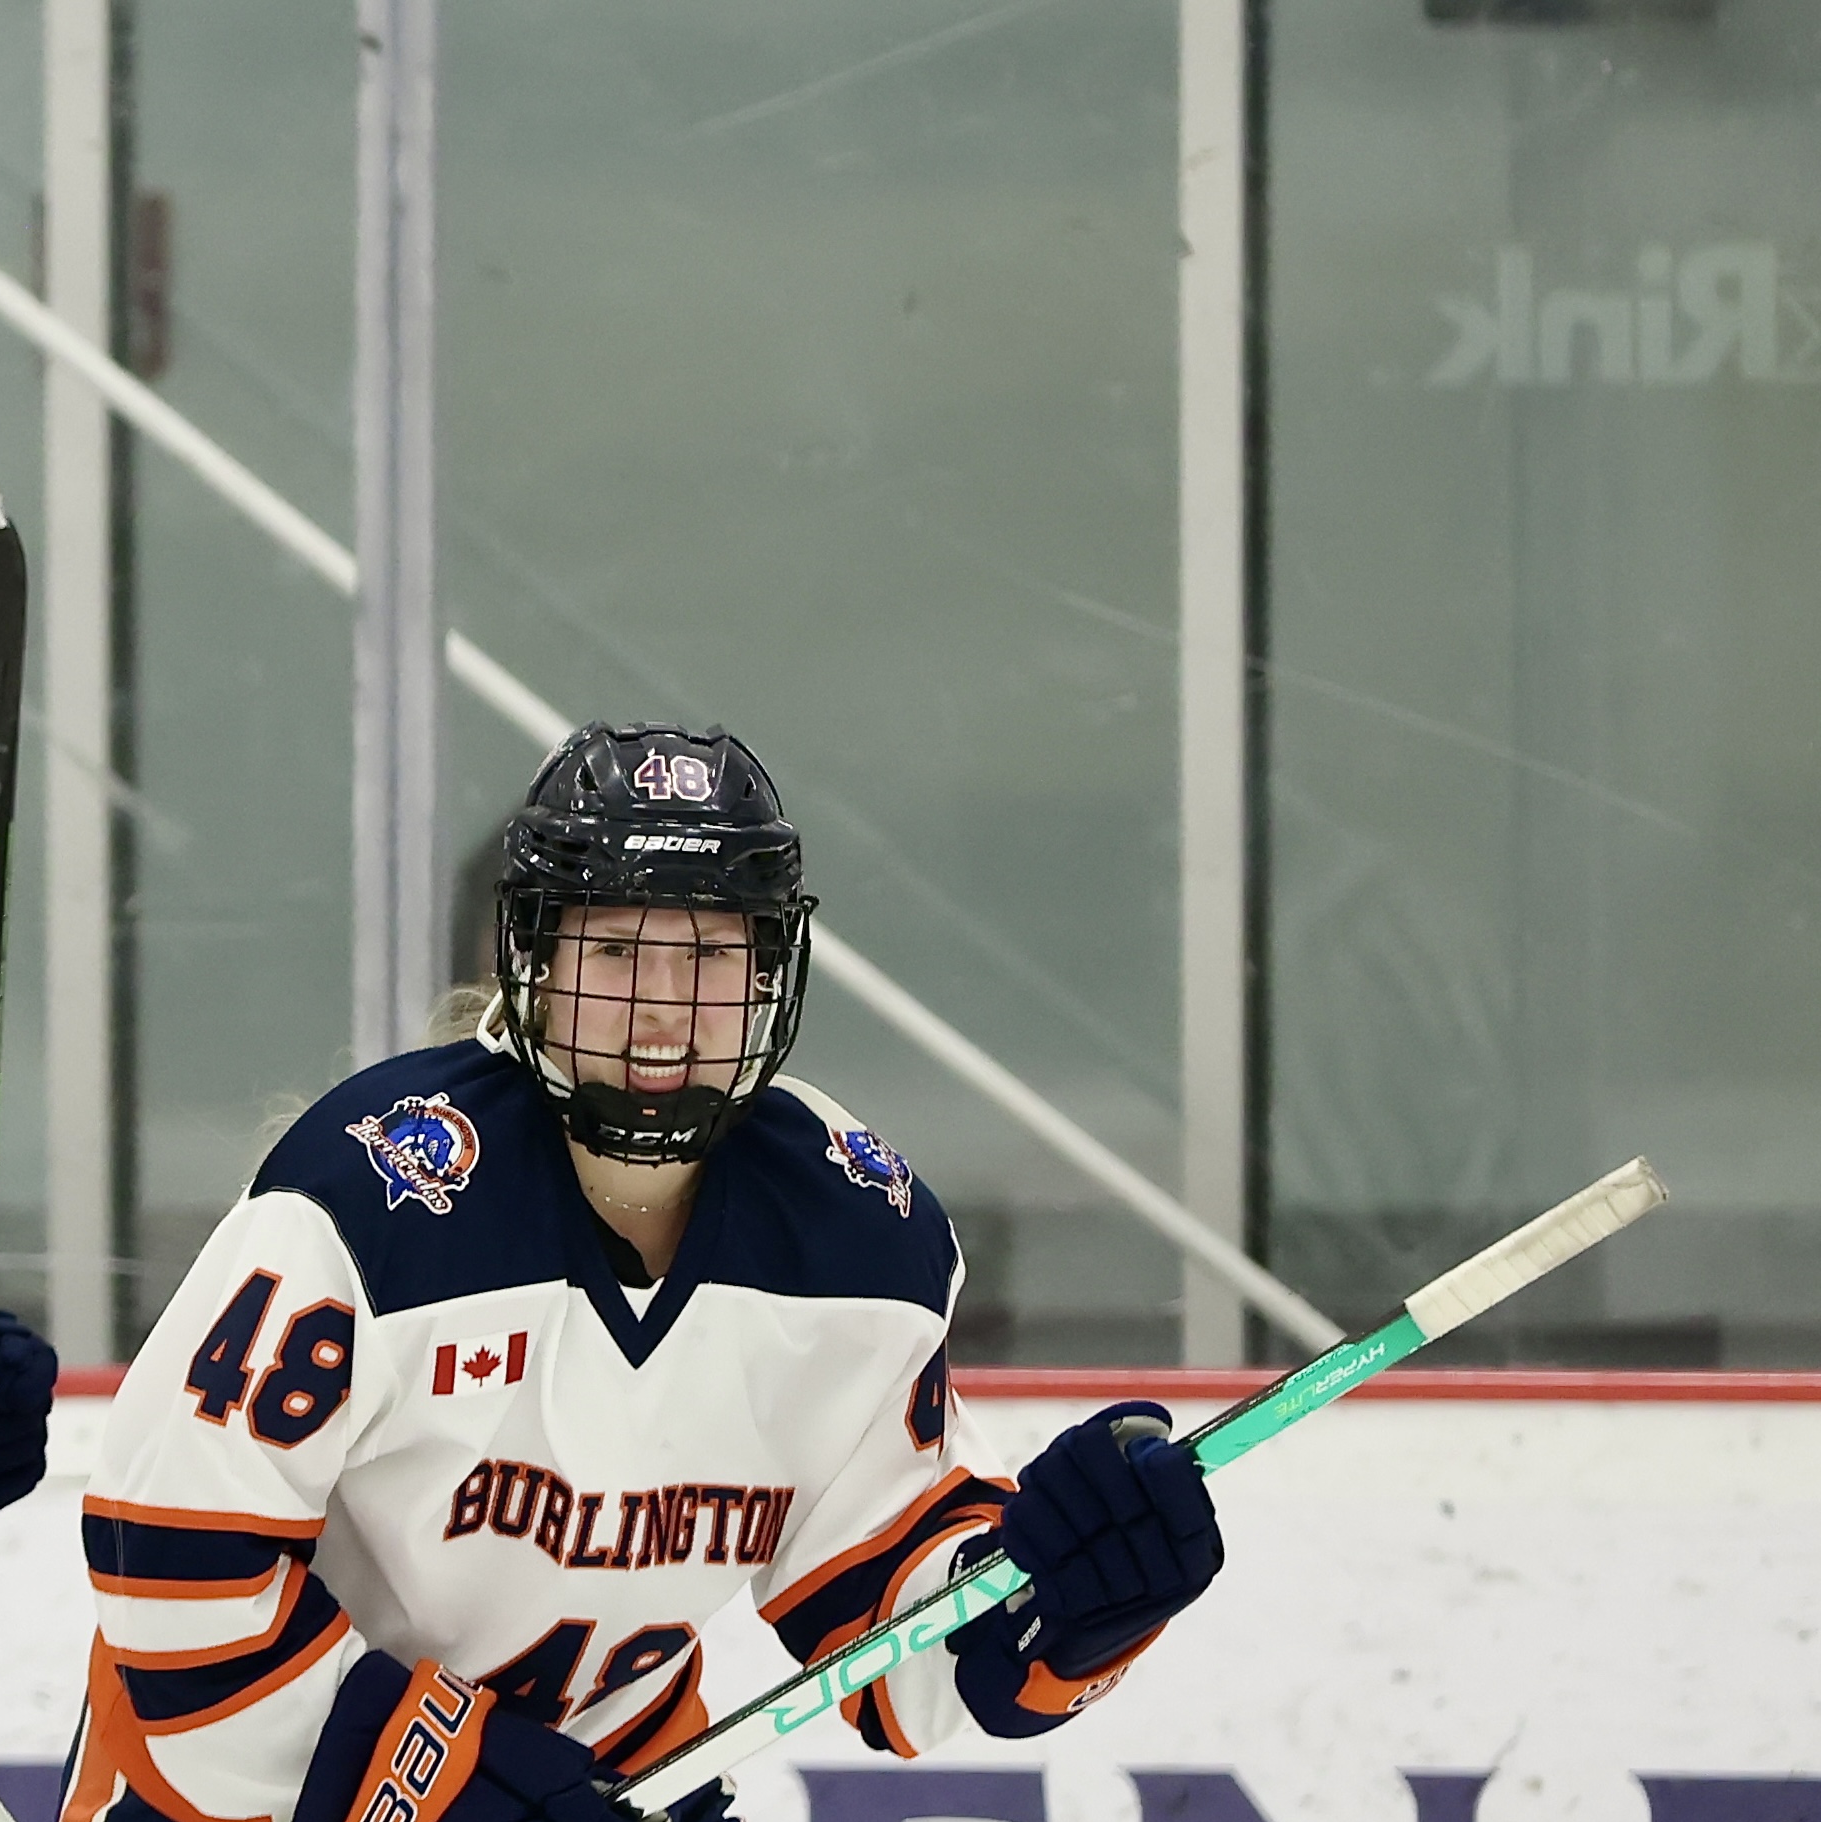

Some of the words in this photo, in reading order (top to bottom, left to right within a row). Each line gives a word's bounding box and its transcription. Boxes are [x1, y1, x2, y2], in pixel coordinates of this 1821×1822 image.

[633, 755, 713, 802] 48
[623, 834, 722, 855] BAUER
[183, 1267, 357, 1451] 48
[441, 1457, 796, 1572] BURLINGTON
[762, 1560, 1027, 1736] APOR
